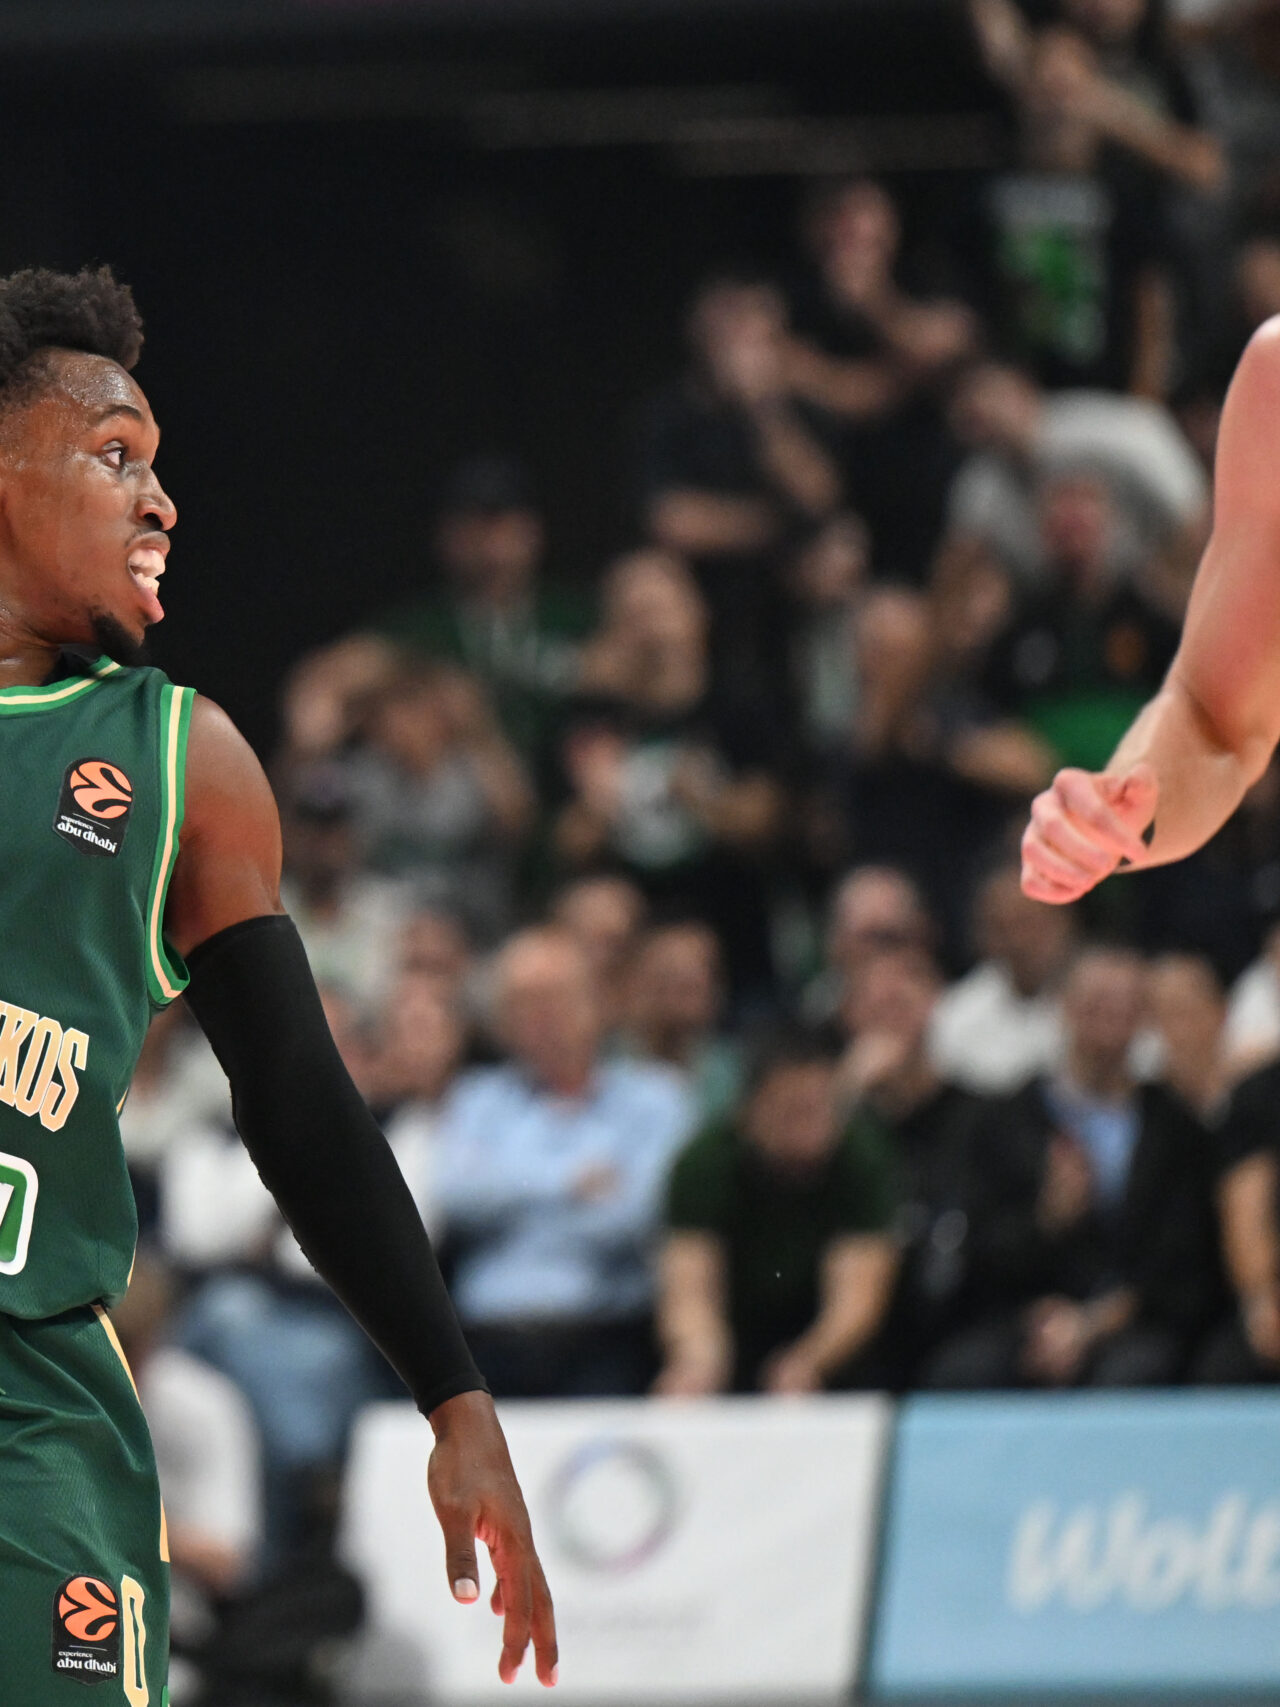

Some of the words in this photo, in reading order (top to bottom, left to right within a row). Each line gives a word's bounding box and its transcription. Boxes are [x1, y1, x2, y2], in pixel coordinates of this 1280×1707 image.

[60, 815, 94, 831] experience
[56, 821, 83, 838] abu
[82, 830, 118, 854] dhabi
[58, 1650, 93, 1658] experience
[56, 1657, 83, 1670] abu
[83, 1659, 117, 1675] dhabi
